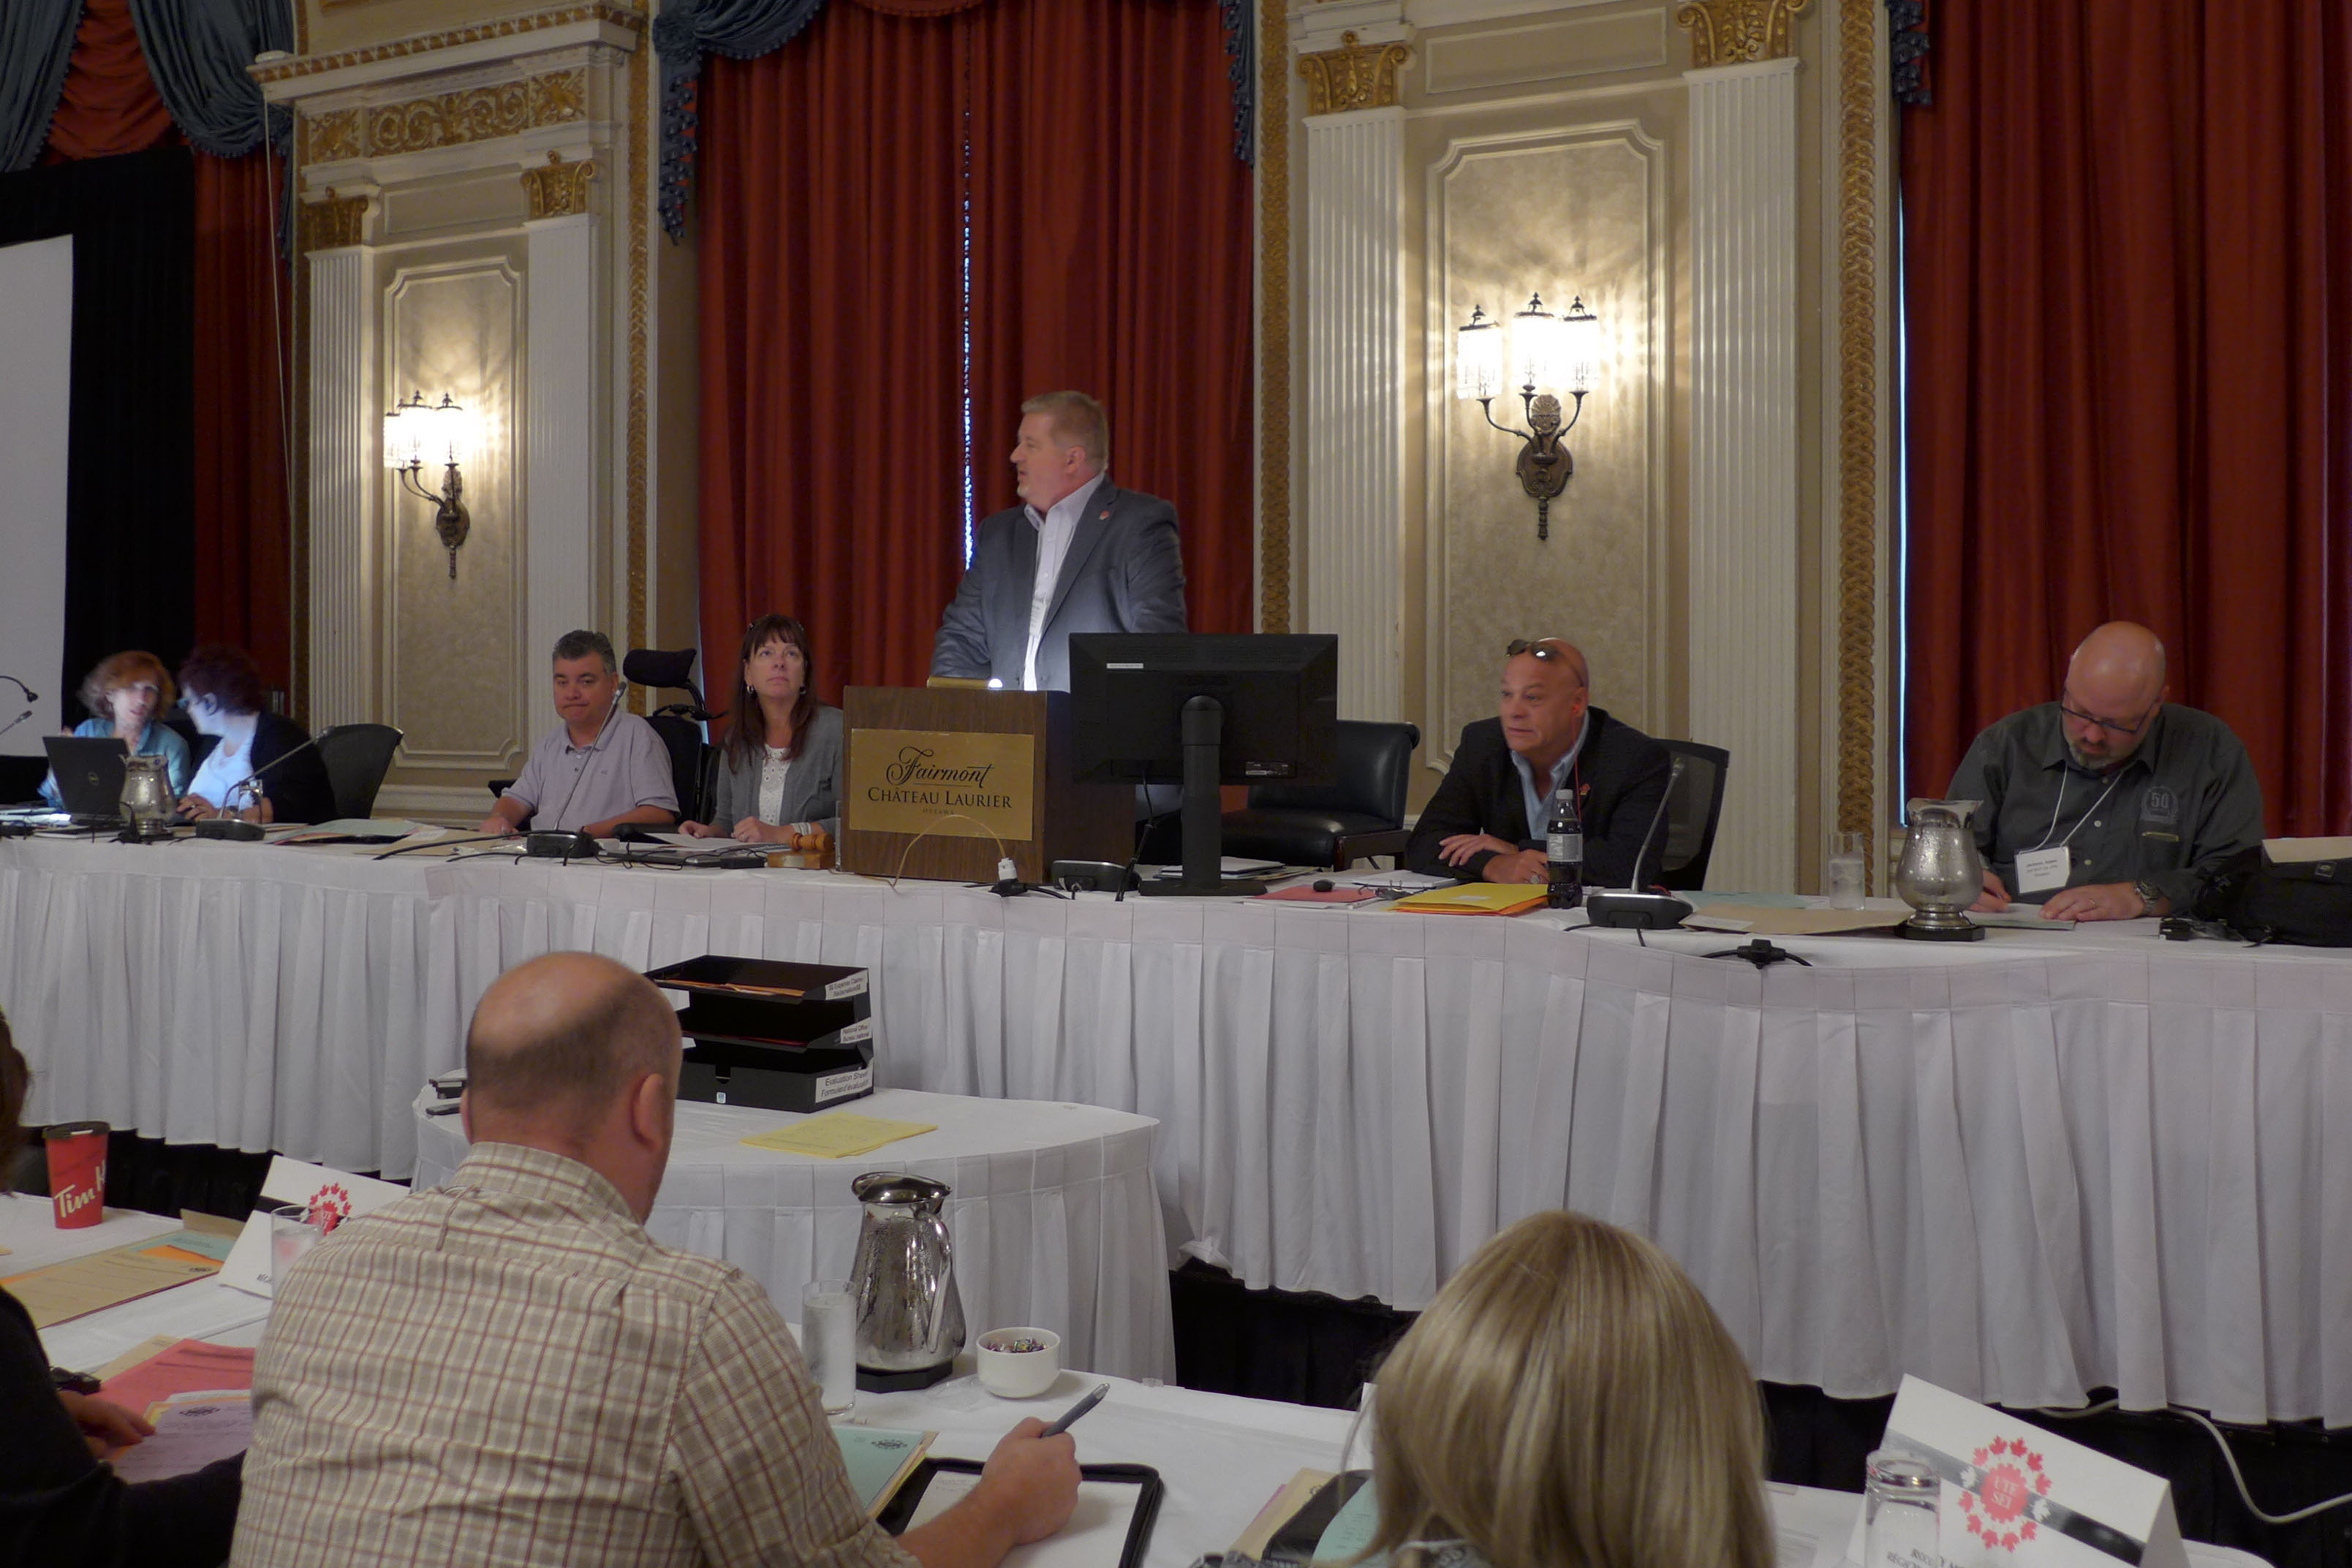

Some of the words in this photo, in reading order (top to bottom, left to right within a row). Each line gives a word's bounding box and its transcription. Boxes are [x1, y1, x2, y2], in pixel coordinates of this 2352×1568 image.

[886, 746, 994, 789] Fairmont
[867, 787, 939, 805] CHÂTEAU
[945, 787, 1013, 808] LAURIER
[54, 1183, 96, 1219] Tim
